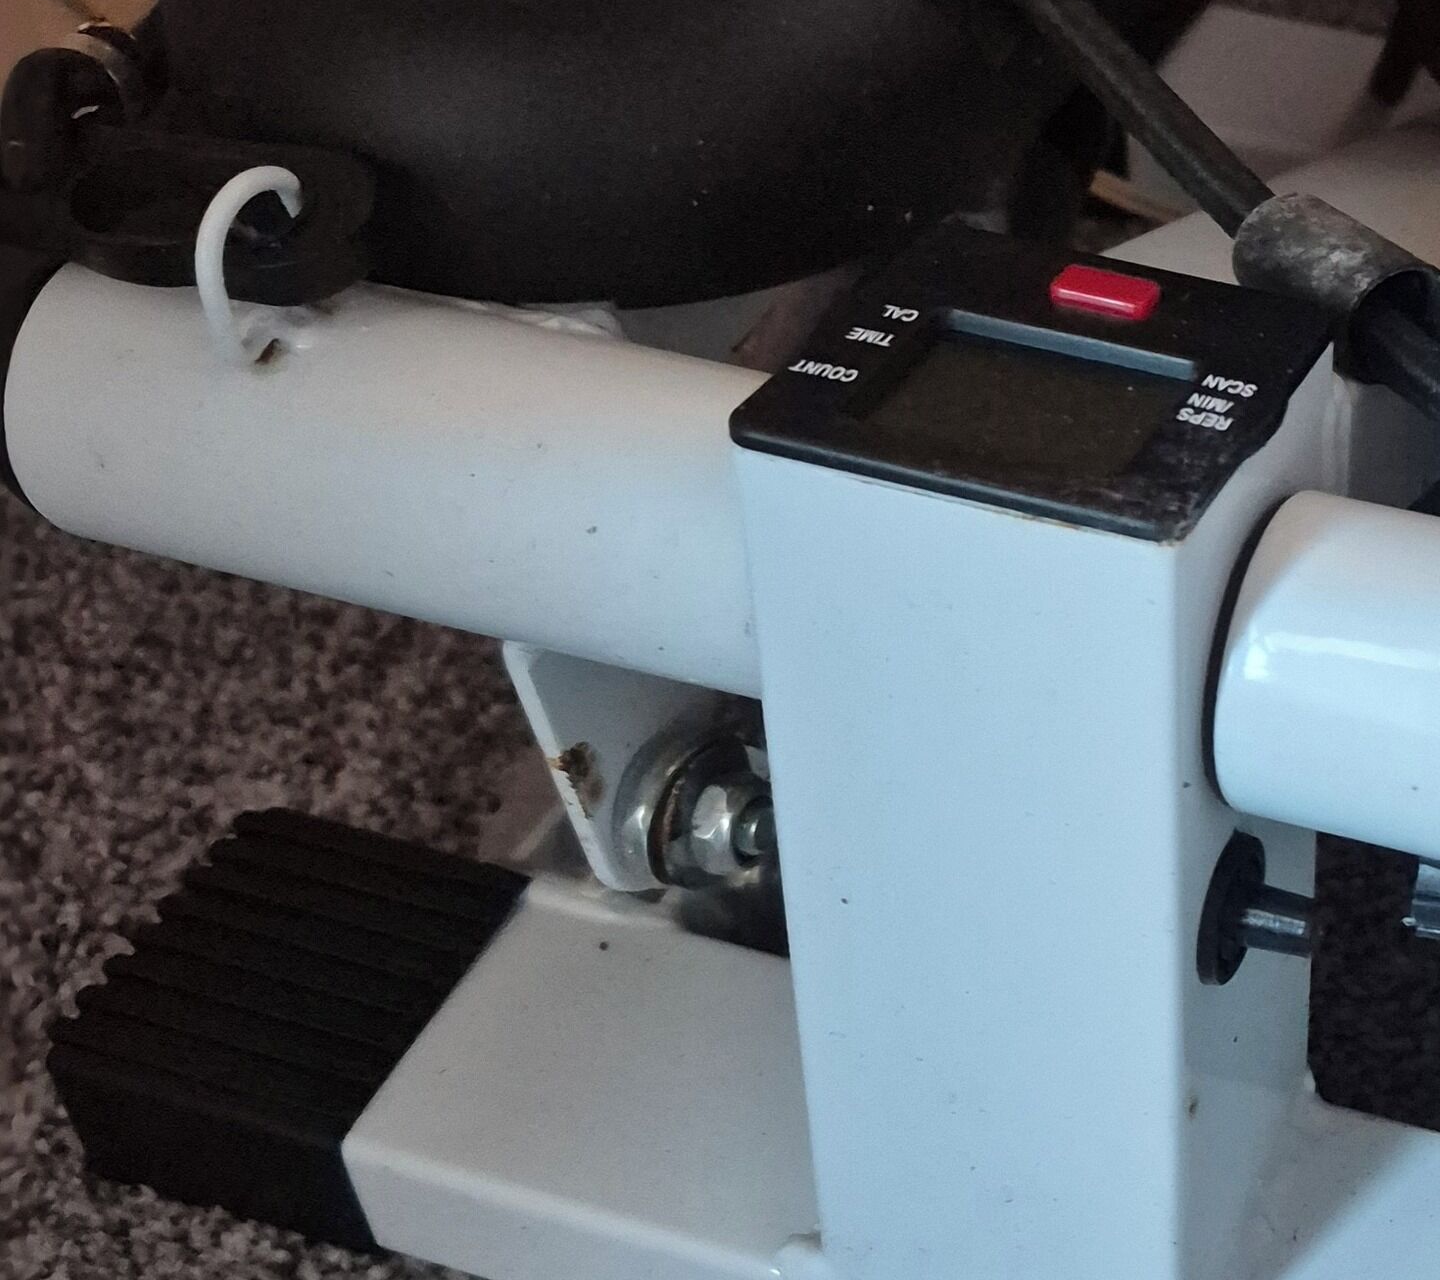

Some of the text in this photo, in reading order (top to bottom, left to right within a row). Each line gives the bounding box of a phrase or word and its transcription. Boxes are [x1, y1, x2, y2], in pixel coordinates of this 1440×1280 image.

[881, 304, 919, 322] CAL
[844, 326, 895, 347] TIME
[787, 359, 859, 382] COUNT
[1201, 373, 1258, 398] SCAN
[1186, 392, 1235, 413] /MIN
[1175, 407, 1234, 431] REPS
